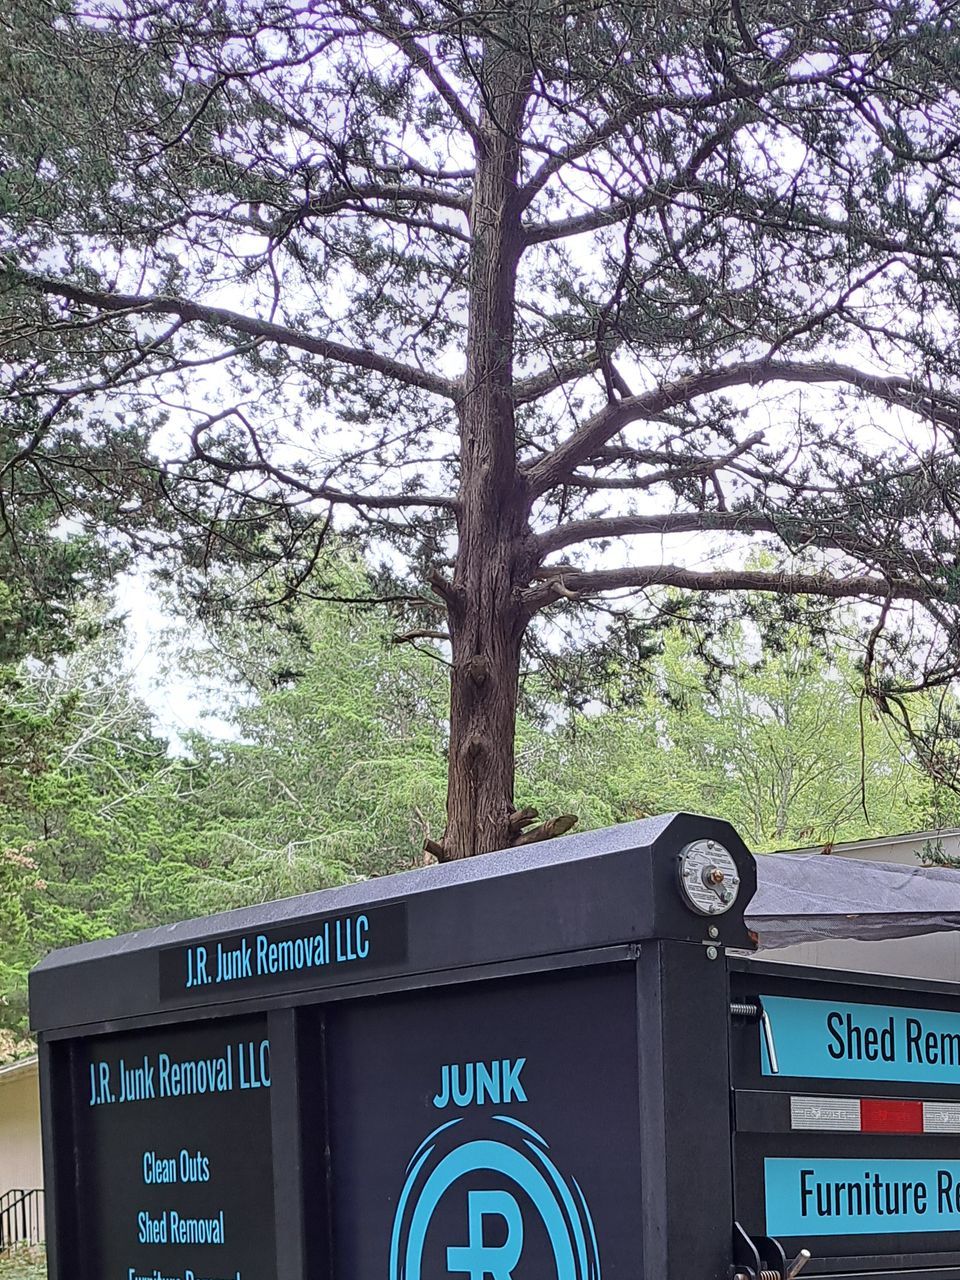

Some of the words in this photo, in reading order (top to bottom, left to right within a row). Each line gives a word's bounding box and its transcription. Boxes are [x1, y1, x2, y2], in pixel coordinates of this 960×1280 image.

[186, 946, 211, 988] J.R.
[216, 938, 252, 982] Junk
[257, 922, 330, 975] Removal
[336, 915, 369, 961] LLC
[827, 1012, 895, 1062] Shed
[90, 1062, 115, 1106] J.R.
[120, 1056, 155, 1102] Junk
[159, 1045, 232, 1097] Removal
[239, 1039, 271, 1088] LLC
[433, 1058, 529, 1109] JUNK
[143, 1151, 176, 1184] Clean
[179, 1150, 210, 1182] Outs
[801, 1170, 926, 1217] Furniture
[138, 1211, 168, 1244] Shed
[171, 1211, 224, 1245] Removal
